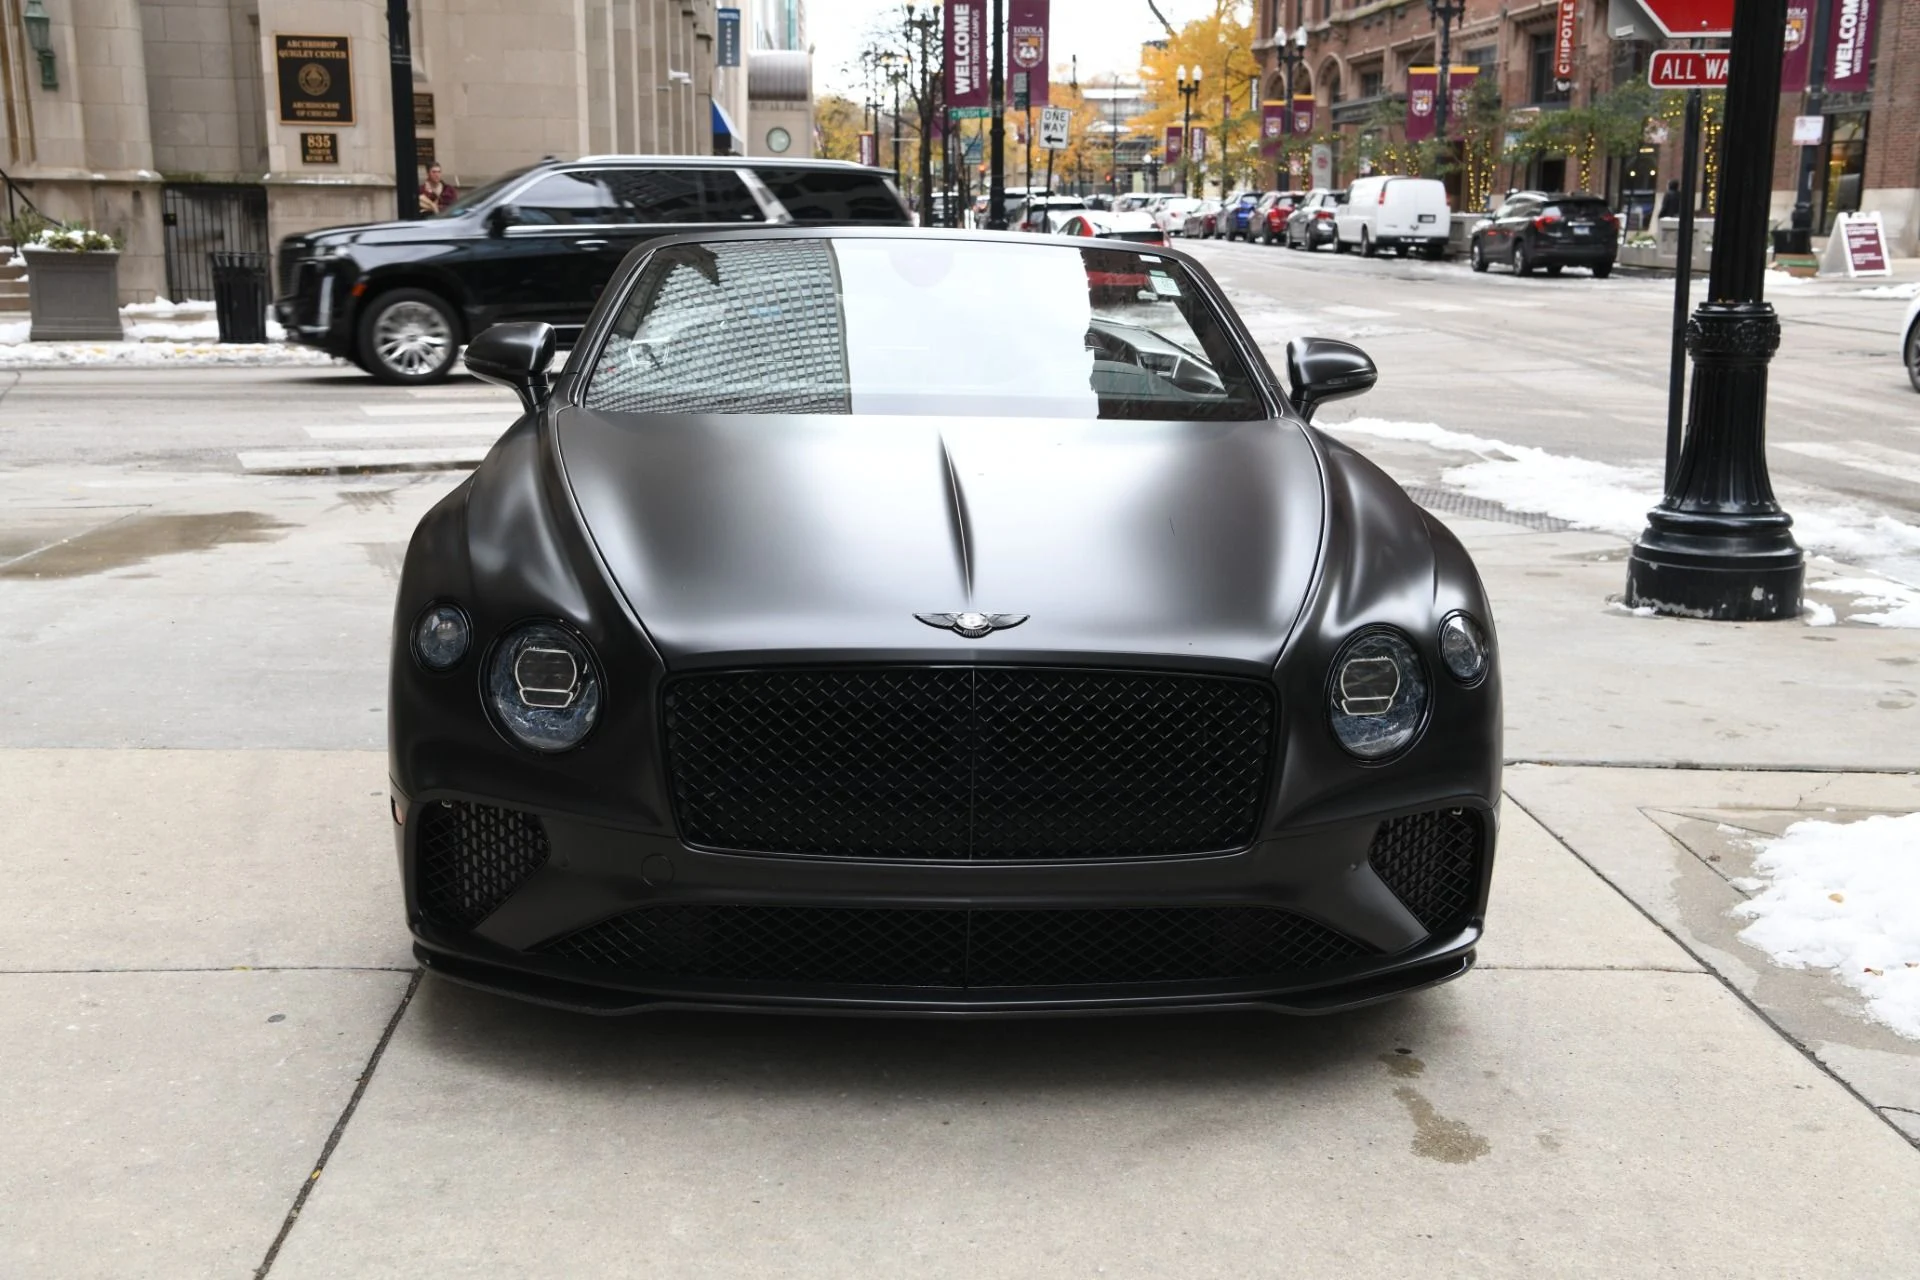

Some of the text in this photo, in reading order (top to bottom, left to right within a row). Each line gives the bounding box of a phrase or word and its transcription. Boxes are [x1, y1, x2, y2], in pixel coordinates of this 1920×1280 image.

[1558, 1, 1575, 74] CHIPOTLE
[1834, 0, 1860, 79] WELCOM
[315, 50, 347, 58] CENTER
[953, 4, 970, 95] WELCOME
[972, 9, 980, 89] WATER TOWER CAMPUS
[1660, 58, 1729, 80] ALL WA
[1044, 110, 1065, 121] ONE
[1043, 122, 1066, 132] WAY
[307, 135, 331, 148] 835
